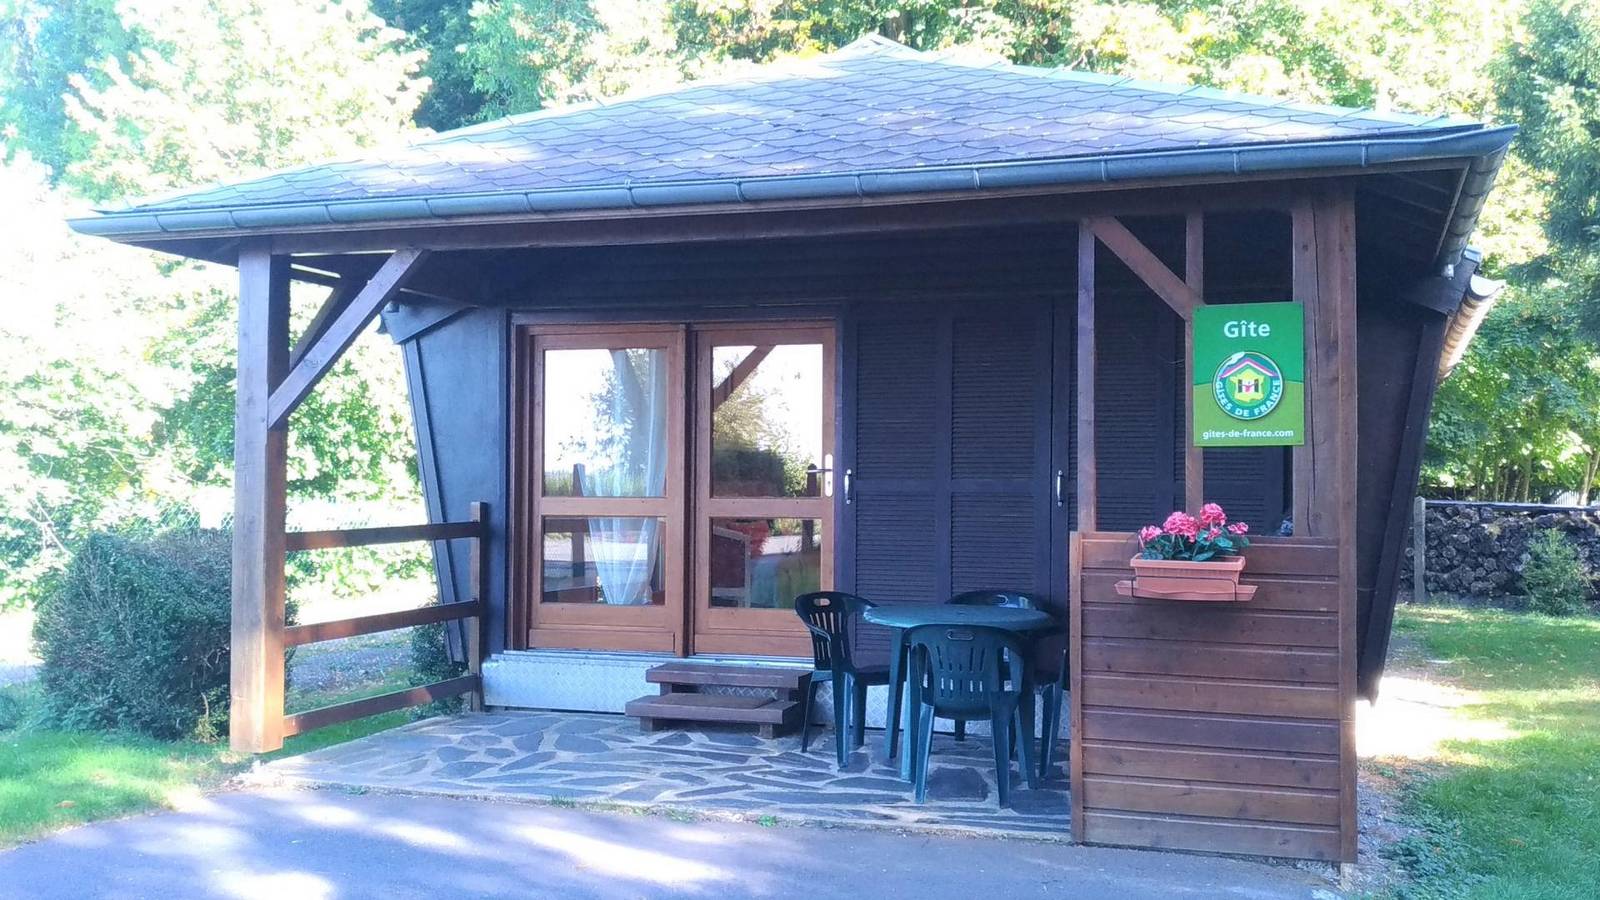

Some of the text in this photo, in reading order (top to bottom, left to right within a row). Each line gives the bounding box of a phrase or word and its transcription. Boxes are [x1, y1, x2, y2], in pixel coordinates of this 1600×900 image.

[1223, 320, 1271, 338] Gîte
[1234, 408, 1250, 417] DE
[1254, 379, 1281, 415] FRANCE
[1202, 428, 1294, 440] gites-de-france.com
